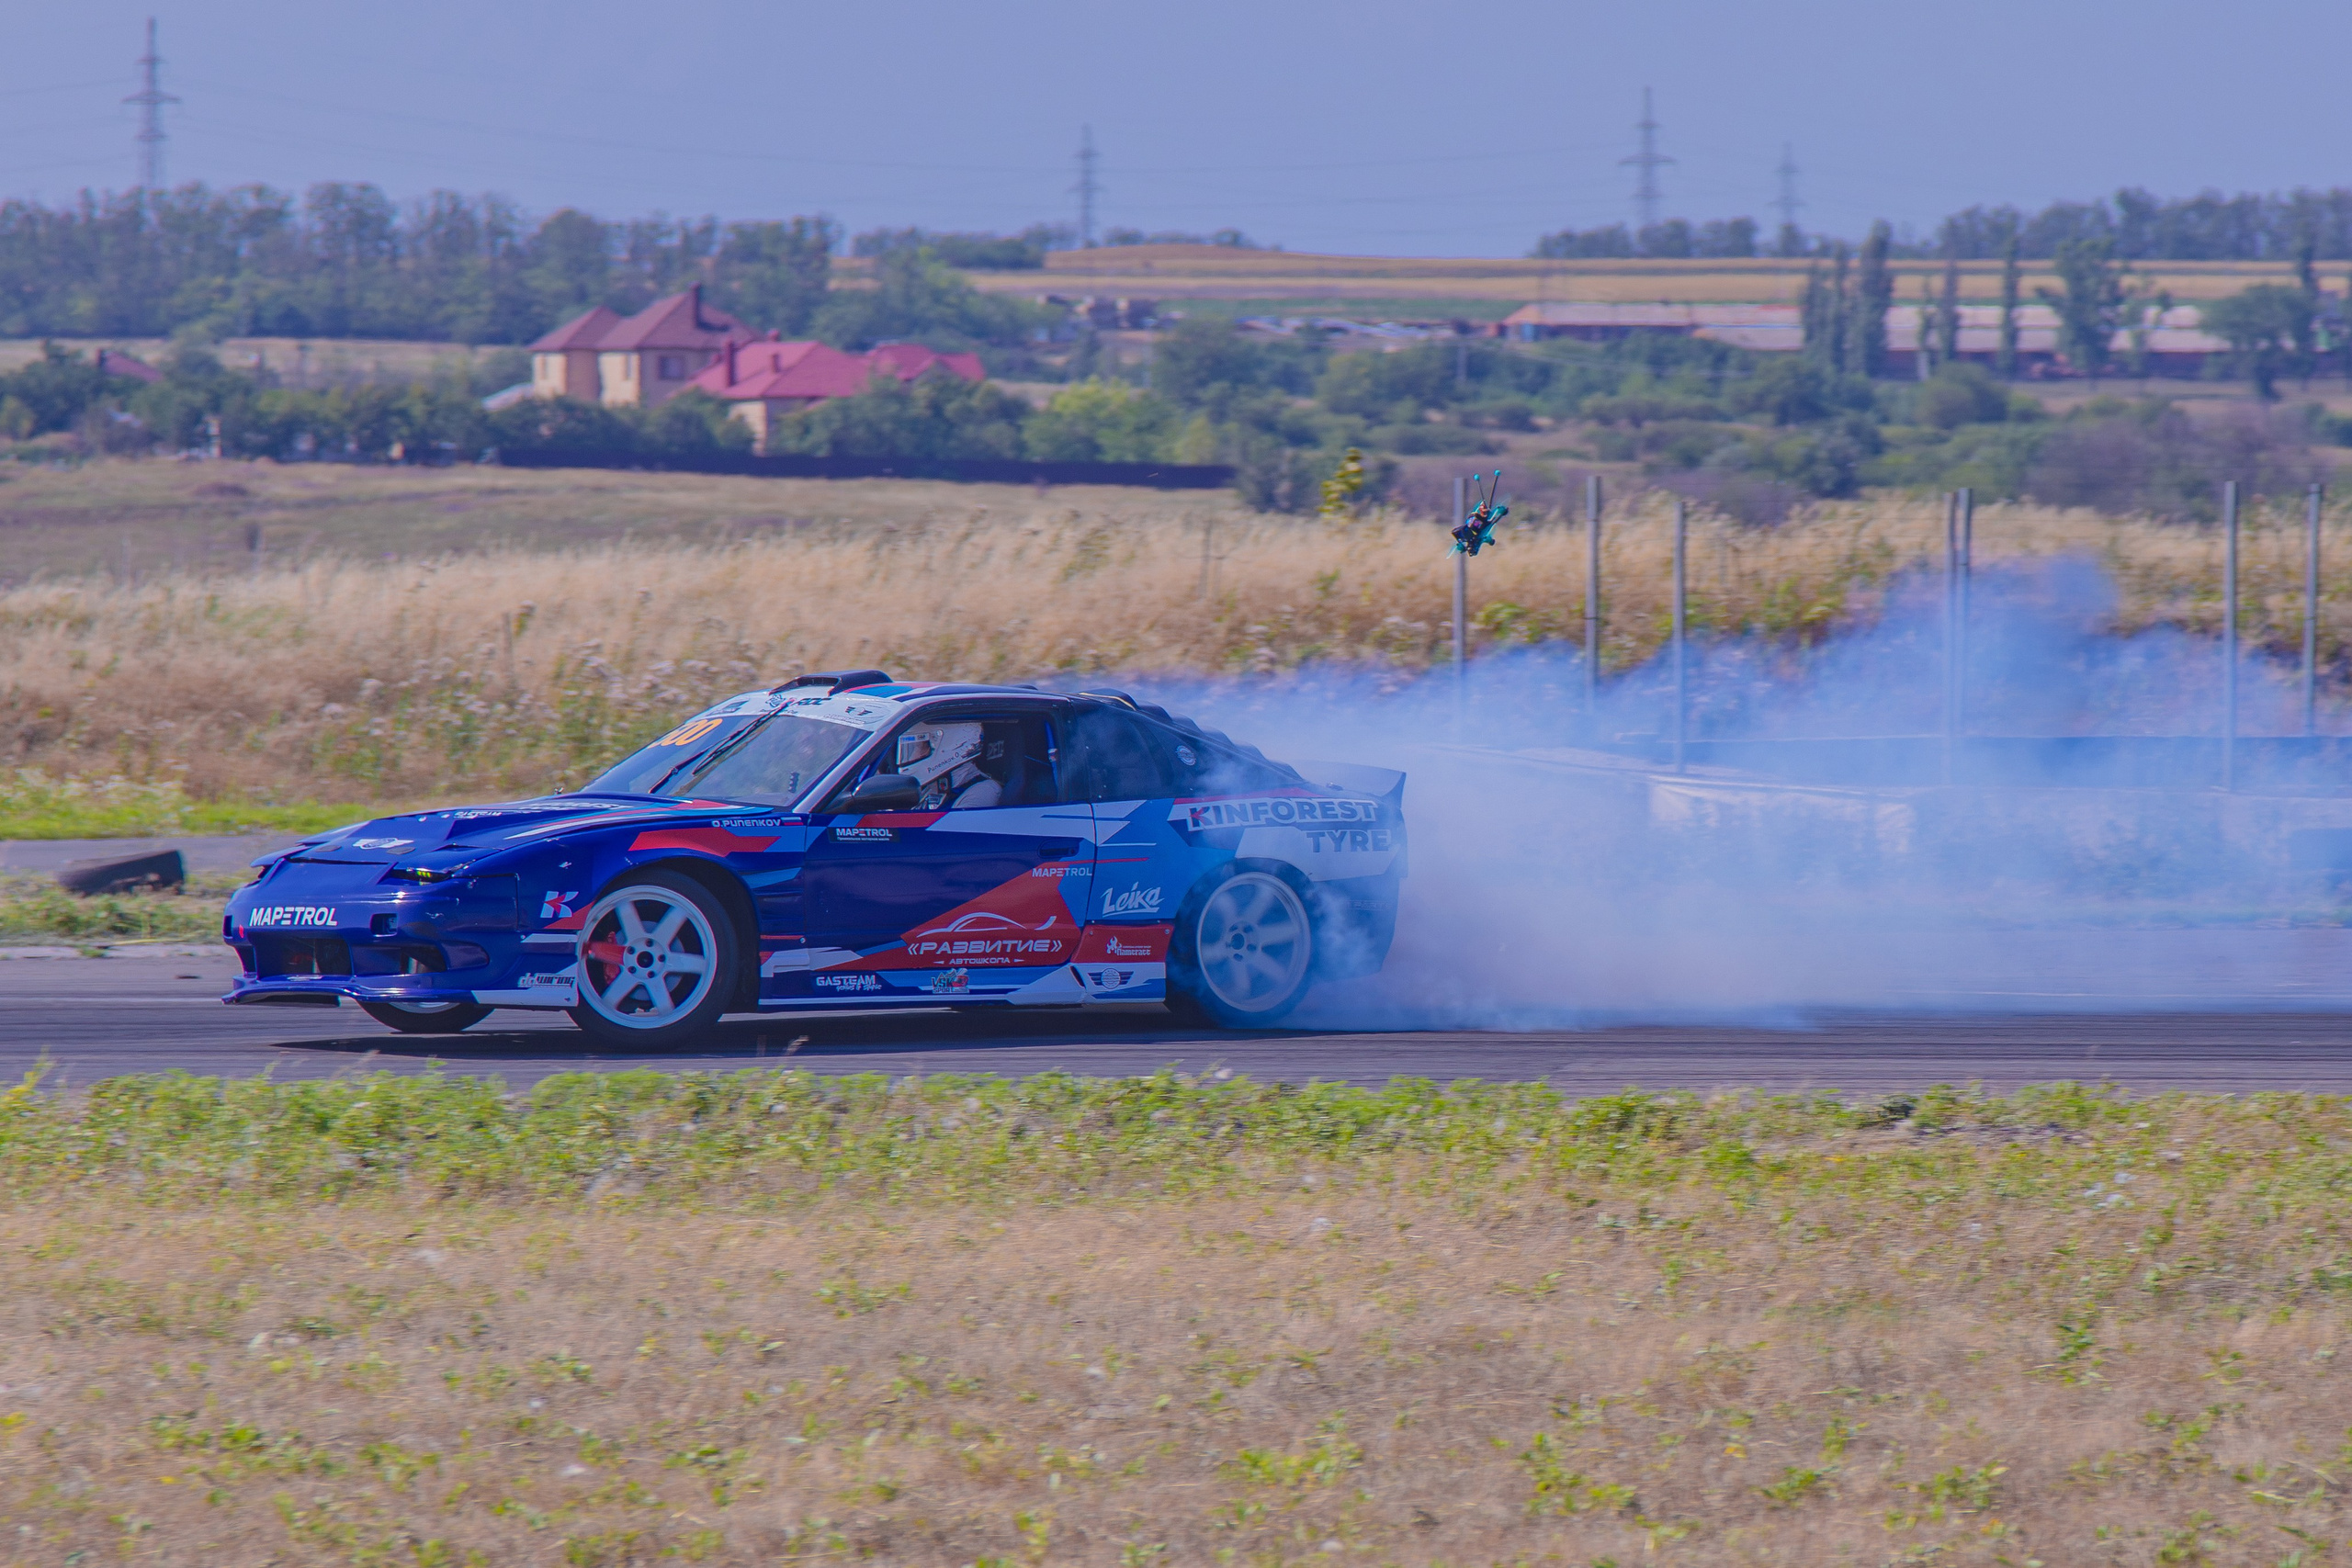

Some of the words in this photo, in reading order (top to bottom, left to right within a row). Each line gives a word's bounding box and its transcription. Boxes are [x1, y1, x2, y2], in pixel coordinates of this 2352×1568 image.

[1189, 801, 1375, 827] KINFOREST
[836, 828, 893, 837] MAPETROL
[1306, 829, 1391, 852] TYRE
[1032, 867, 1093, 877] MAPETROL
[1101, 882, 1165, 917] Leika
[249, 907, 338, 927] MAPETROL
[816, 975, 876, 986] GASTEAM
